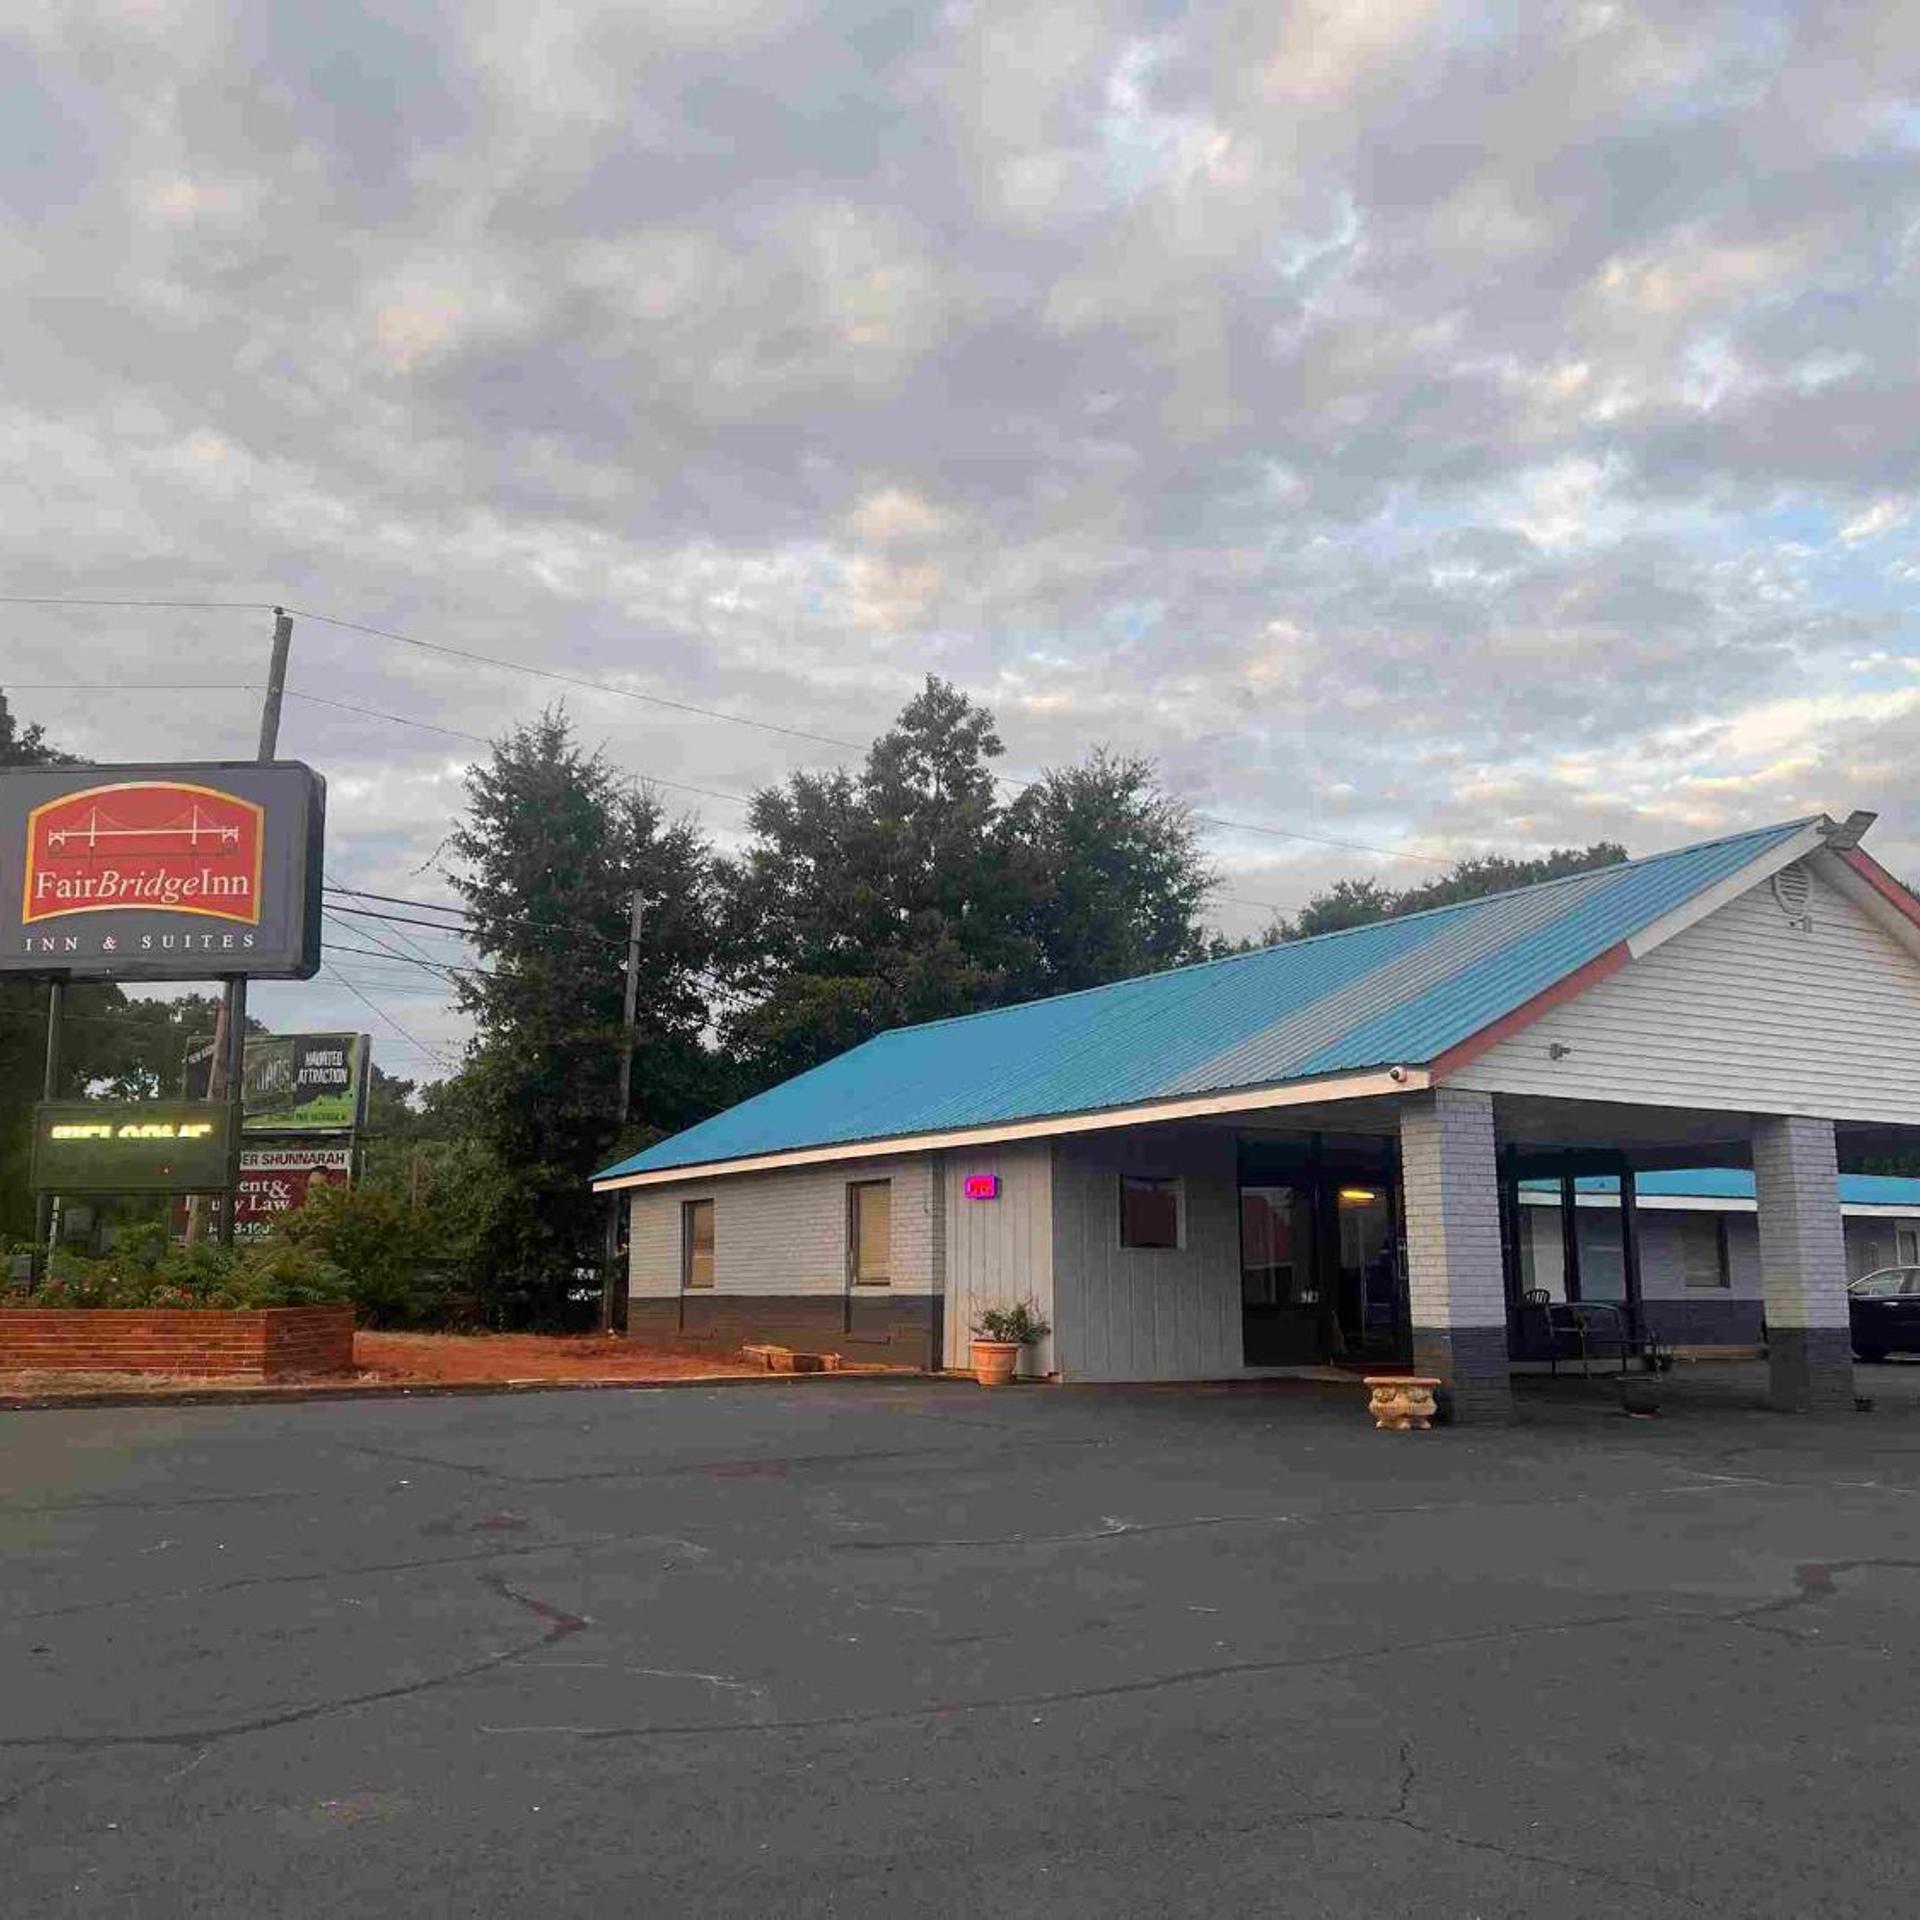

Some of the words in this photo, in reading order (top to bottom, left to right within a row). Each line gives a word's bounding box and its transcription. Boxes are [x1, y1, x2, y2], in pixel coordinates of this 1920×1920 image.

[22, 936, 78, 952] INN
[102, 936, 118, 951] &
[140, 934, 255, 949] SUITES
[304, 1049, 344, 1067] HAUNTED
[297, 1067, 348, 1084] ATTRACTION
[261, 1151, 346, 1165] SHUNNARAH
[249, 1195, 290, 1211] Law
